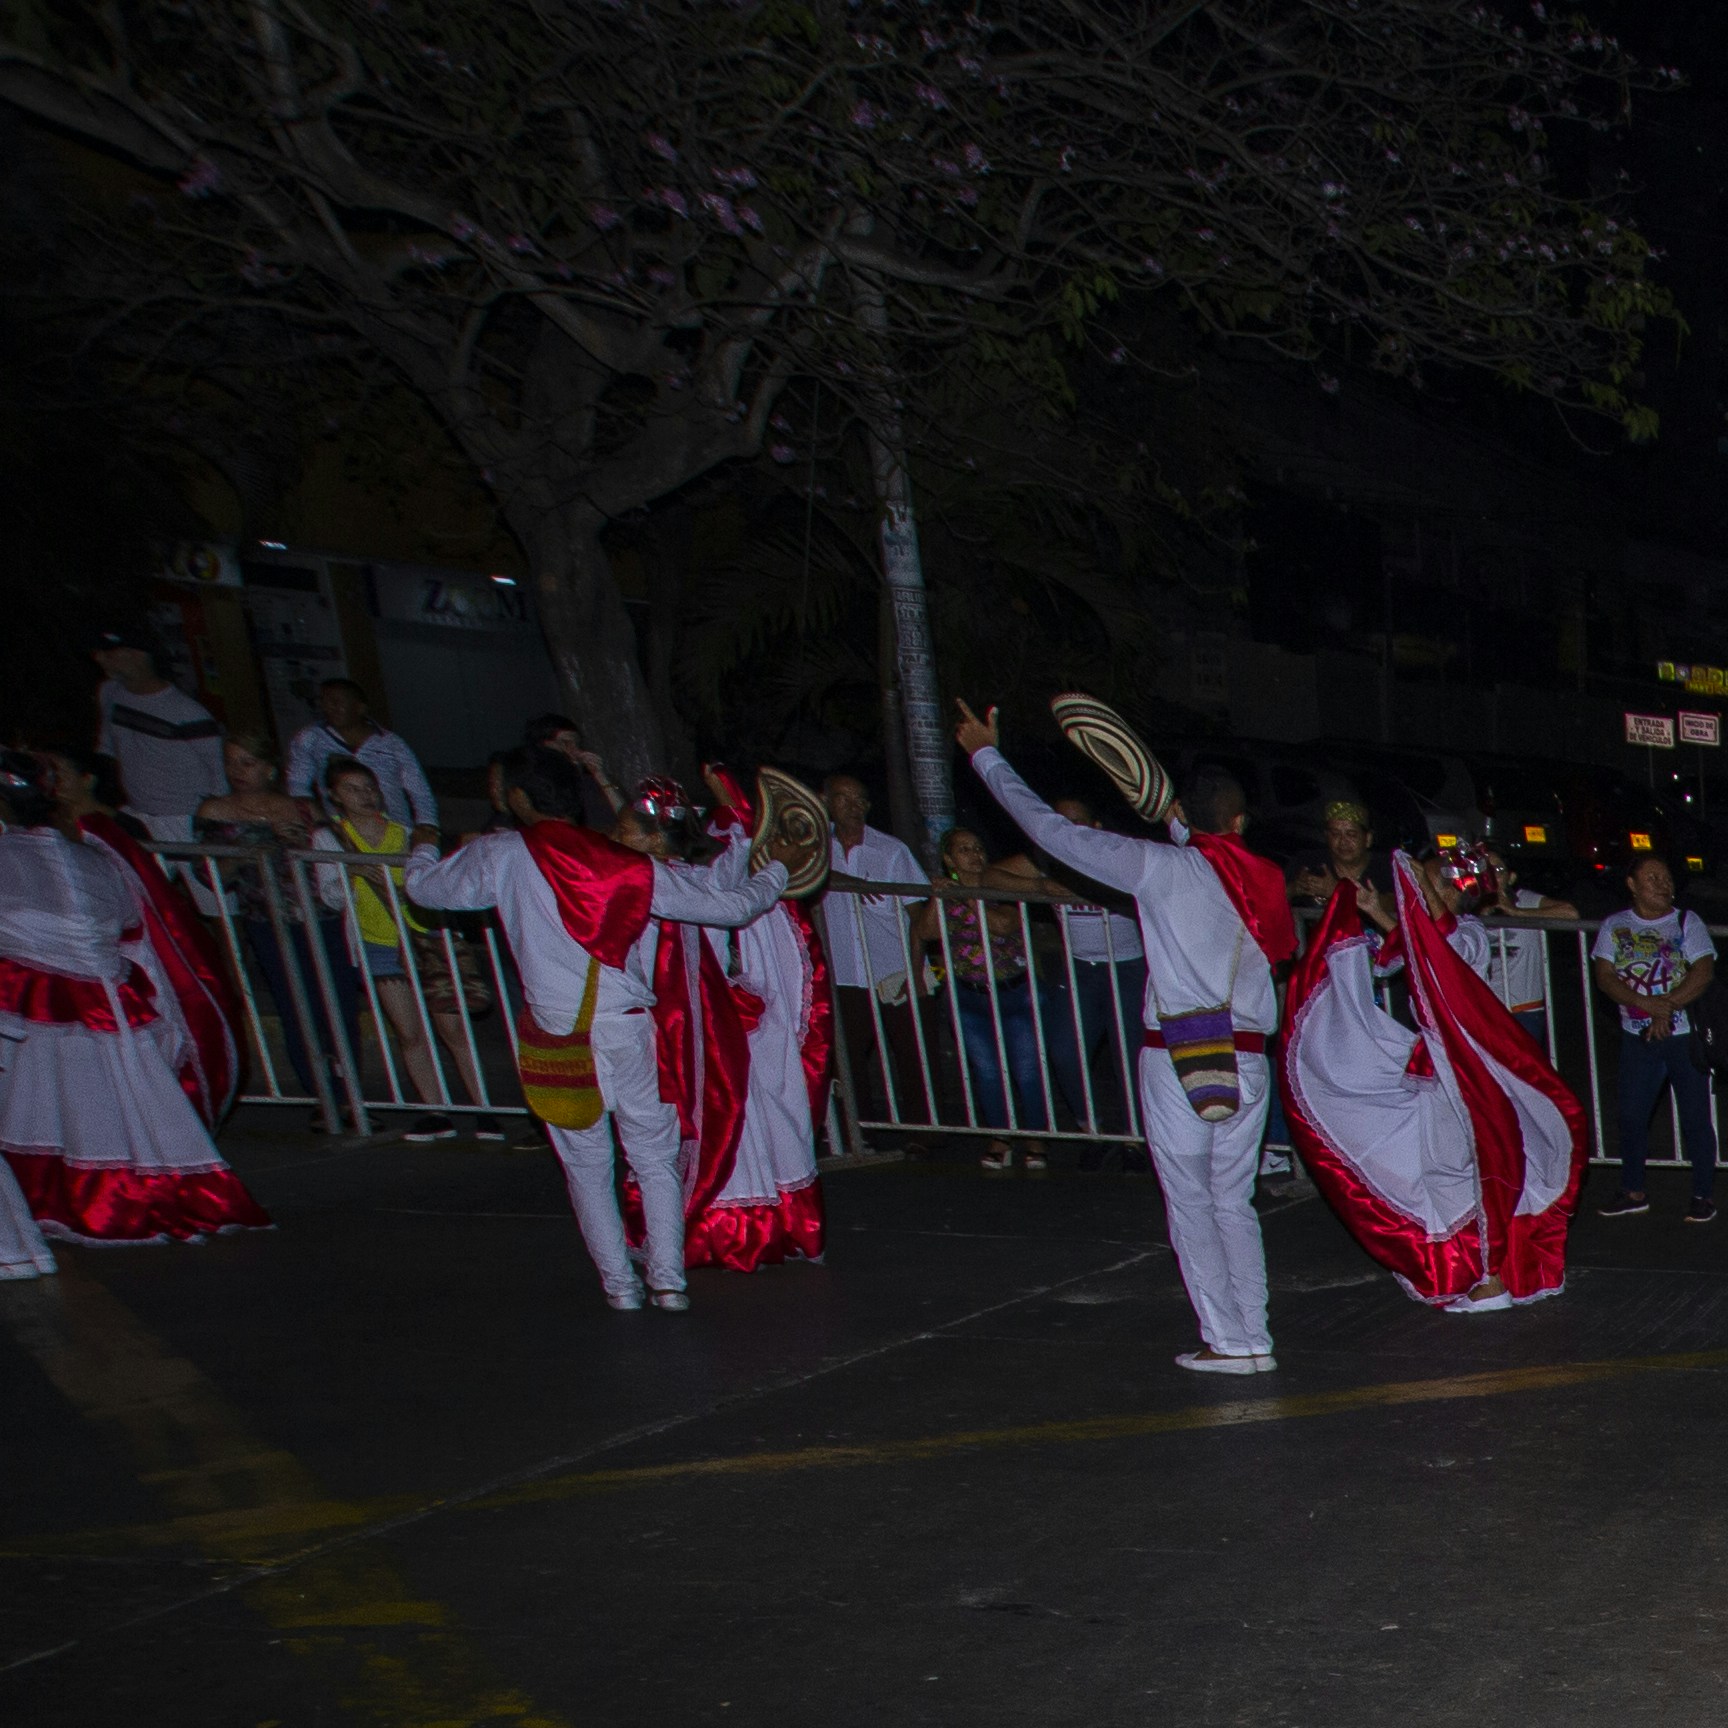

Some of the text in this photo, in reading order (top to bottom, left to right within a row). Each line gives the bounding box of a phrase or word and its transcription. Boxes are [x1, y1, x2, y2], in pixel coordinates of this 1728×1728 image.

[1633, 717, 1665, 728] ENTRADA
[1642, 725, 1665, 737] SALIDA
[1690, 729, 1708, 737] OBRA
[1629, 733, 1637, 741] DE
